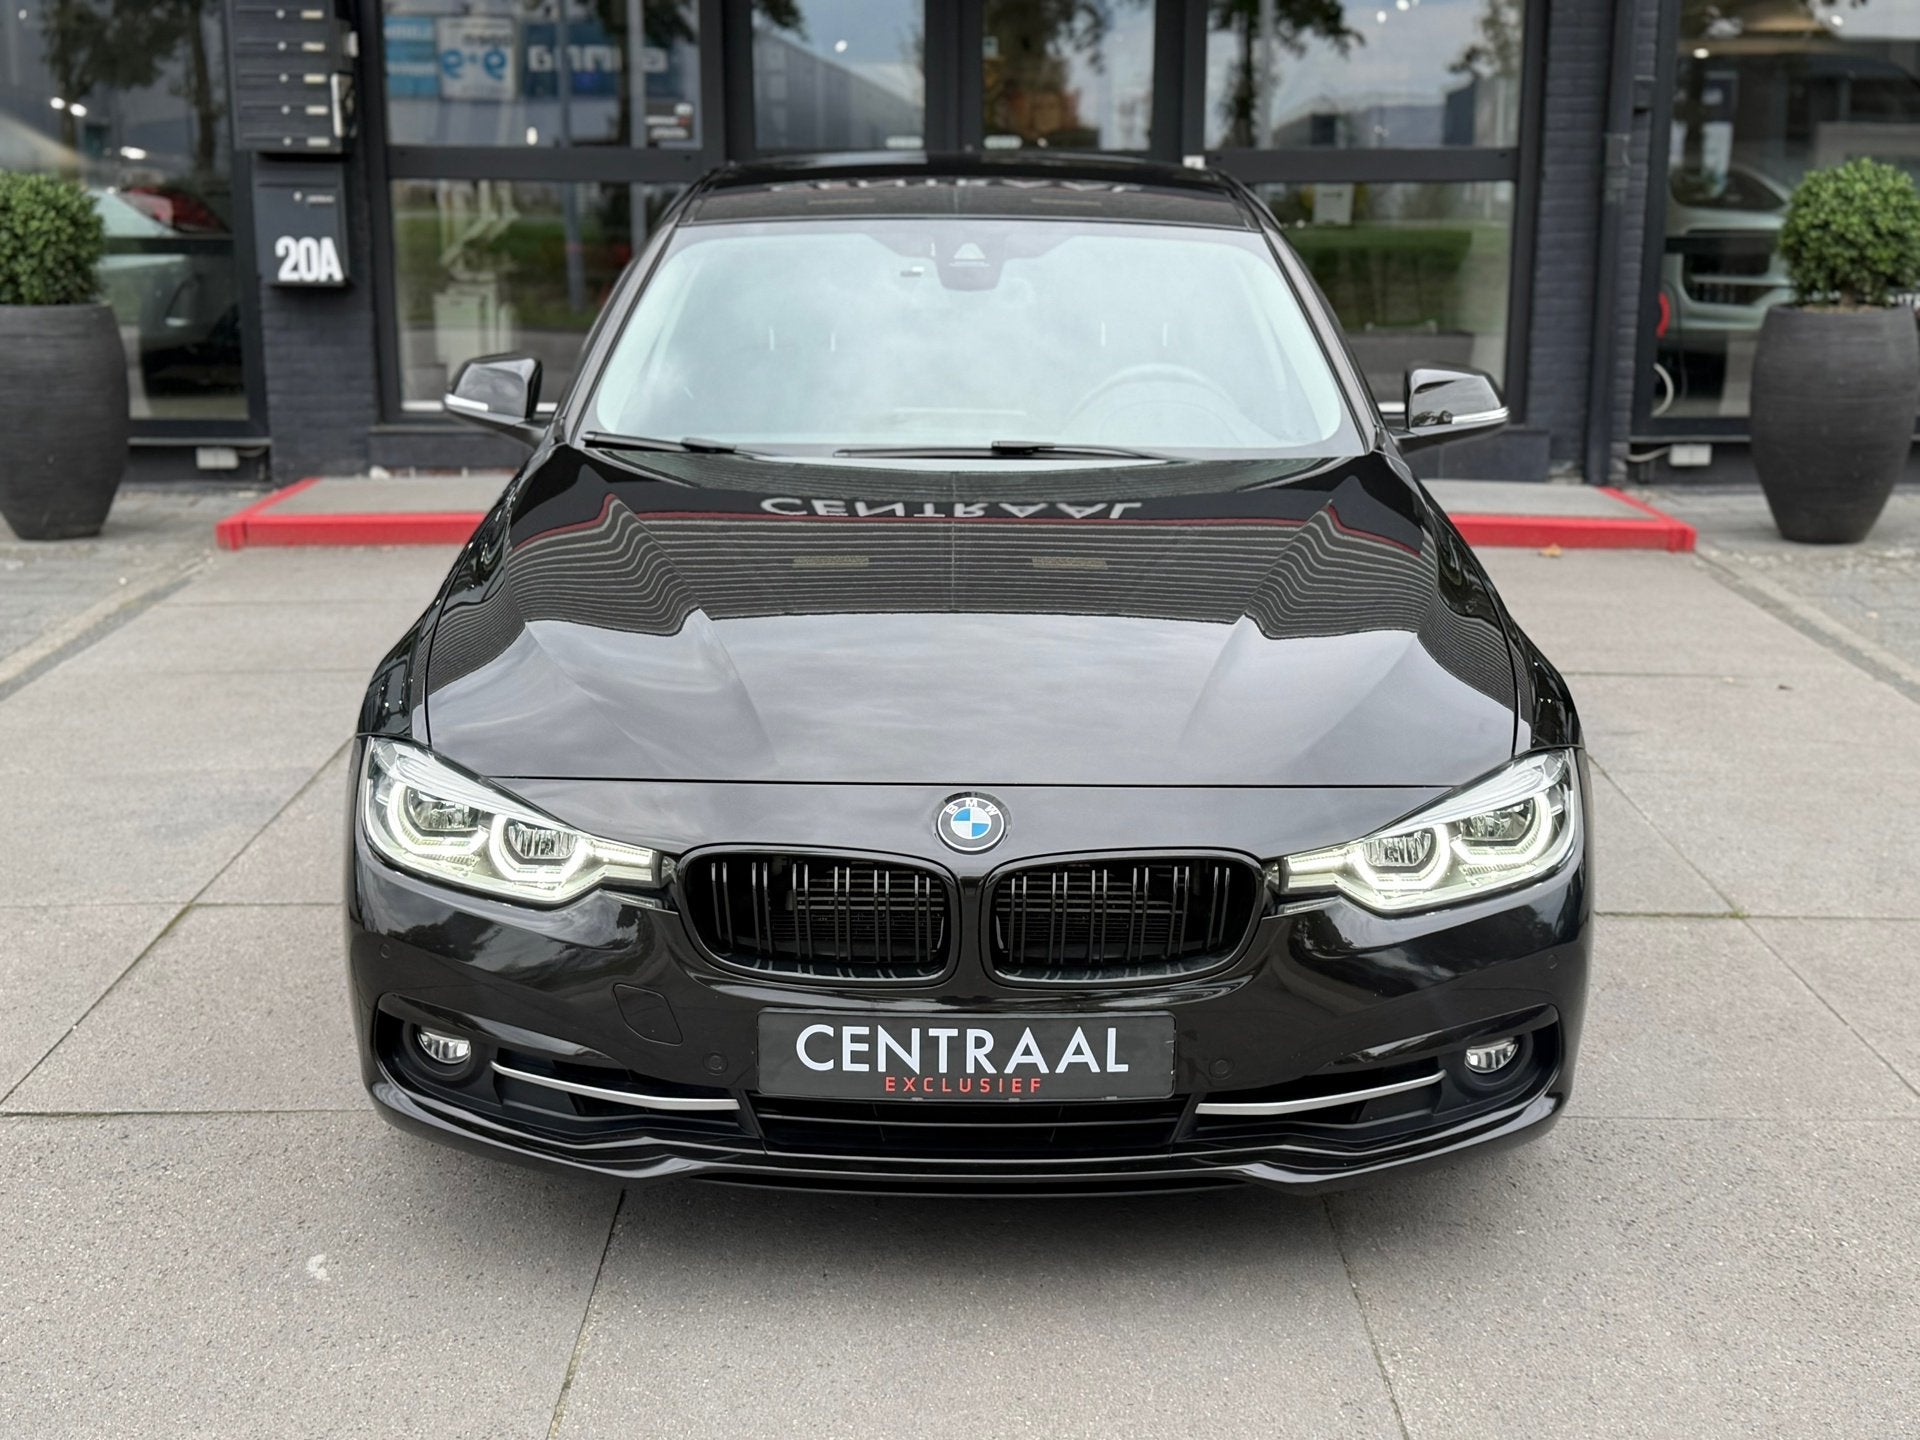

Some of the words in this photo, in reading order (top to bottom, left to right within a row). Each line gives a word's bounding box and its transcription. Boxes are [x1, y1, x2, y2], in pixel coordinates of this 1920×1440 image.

[275, 236, 344, 282] 20A
[945, 799, 1000, 817] BMW
[796, 1024, 1129, 1074] CENTRAAL
[885, 1076, 1042, 1094] EXCLUSIEF
